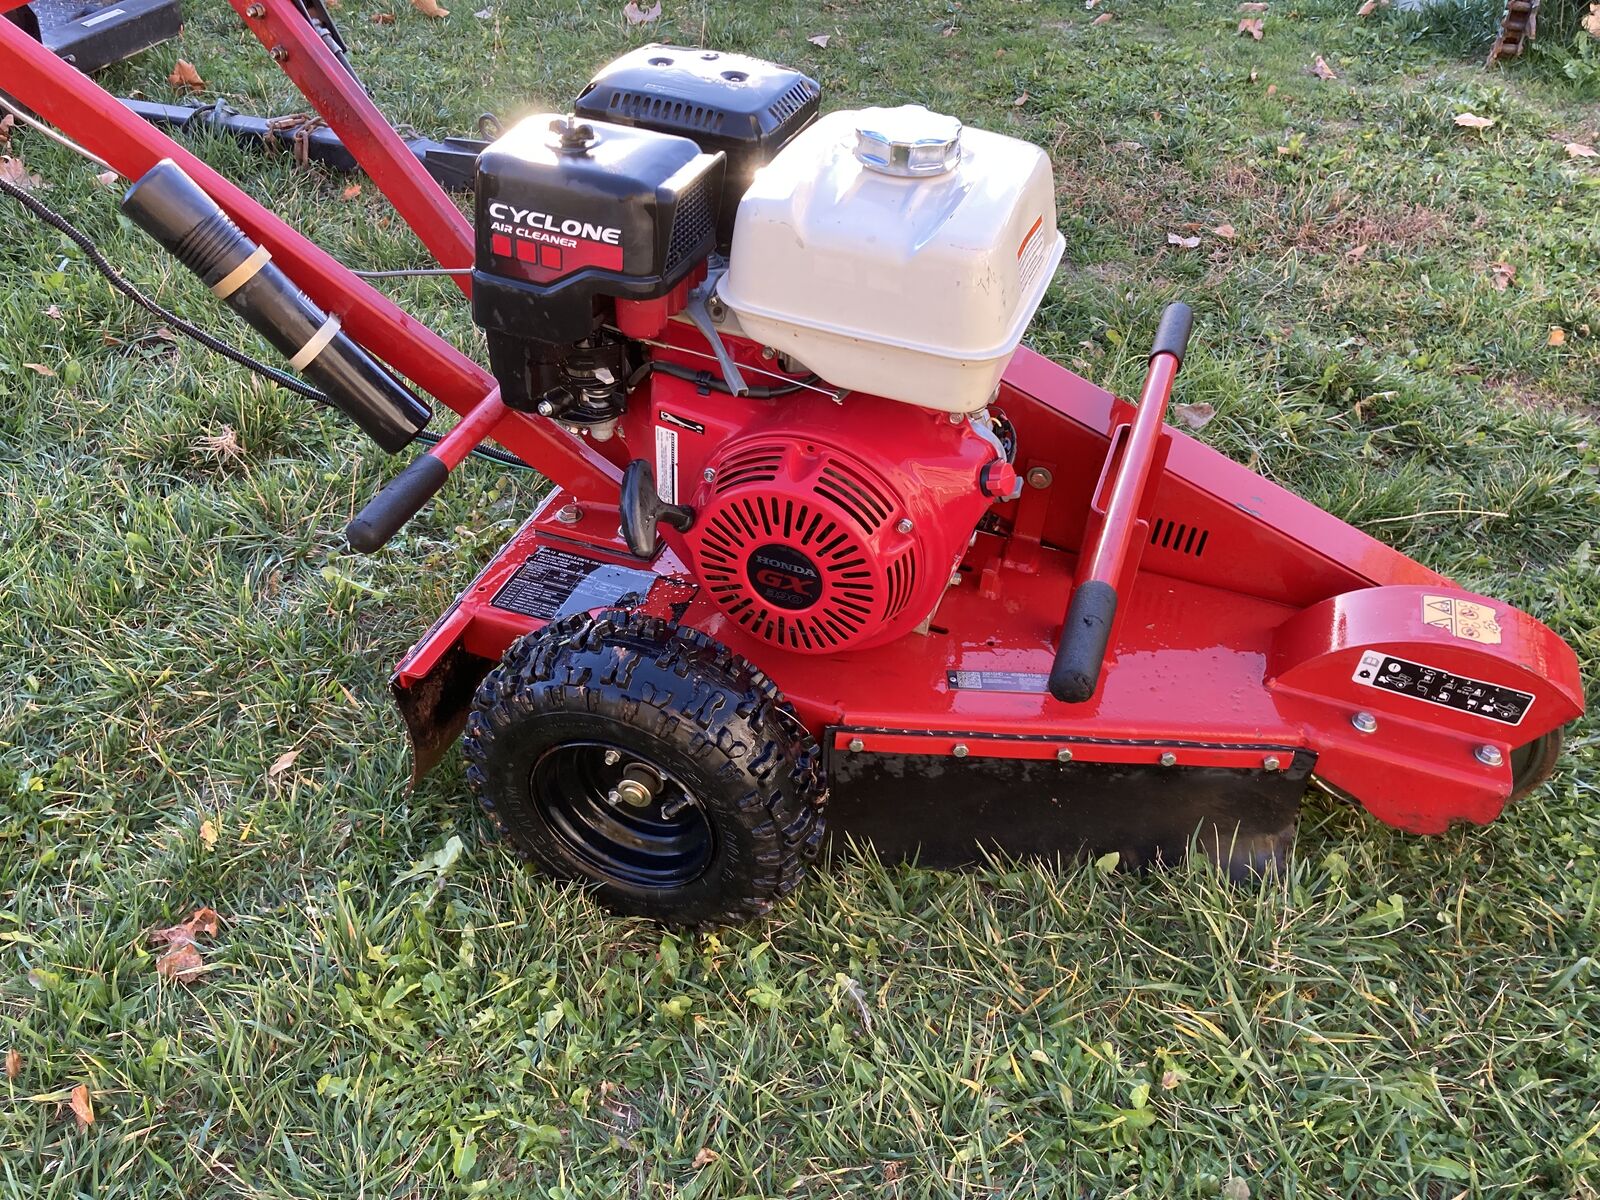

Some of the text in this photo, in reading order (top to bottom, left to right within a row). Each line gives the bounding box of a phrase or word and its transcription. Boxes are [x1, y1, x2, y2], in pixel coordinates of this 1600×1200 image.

[489, 202, 621, 245] CYCLONE
[491, 221, 577, 248] AIR CLEANER
[756, 555, 817, 578] HONDA
[756, 569, 814, 595] GX
